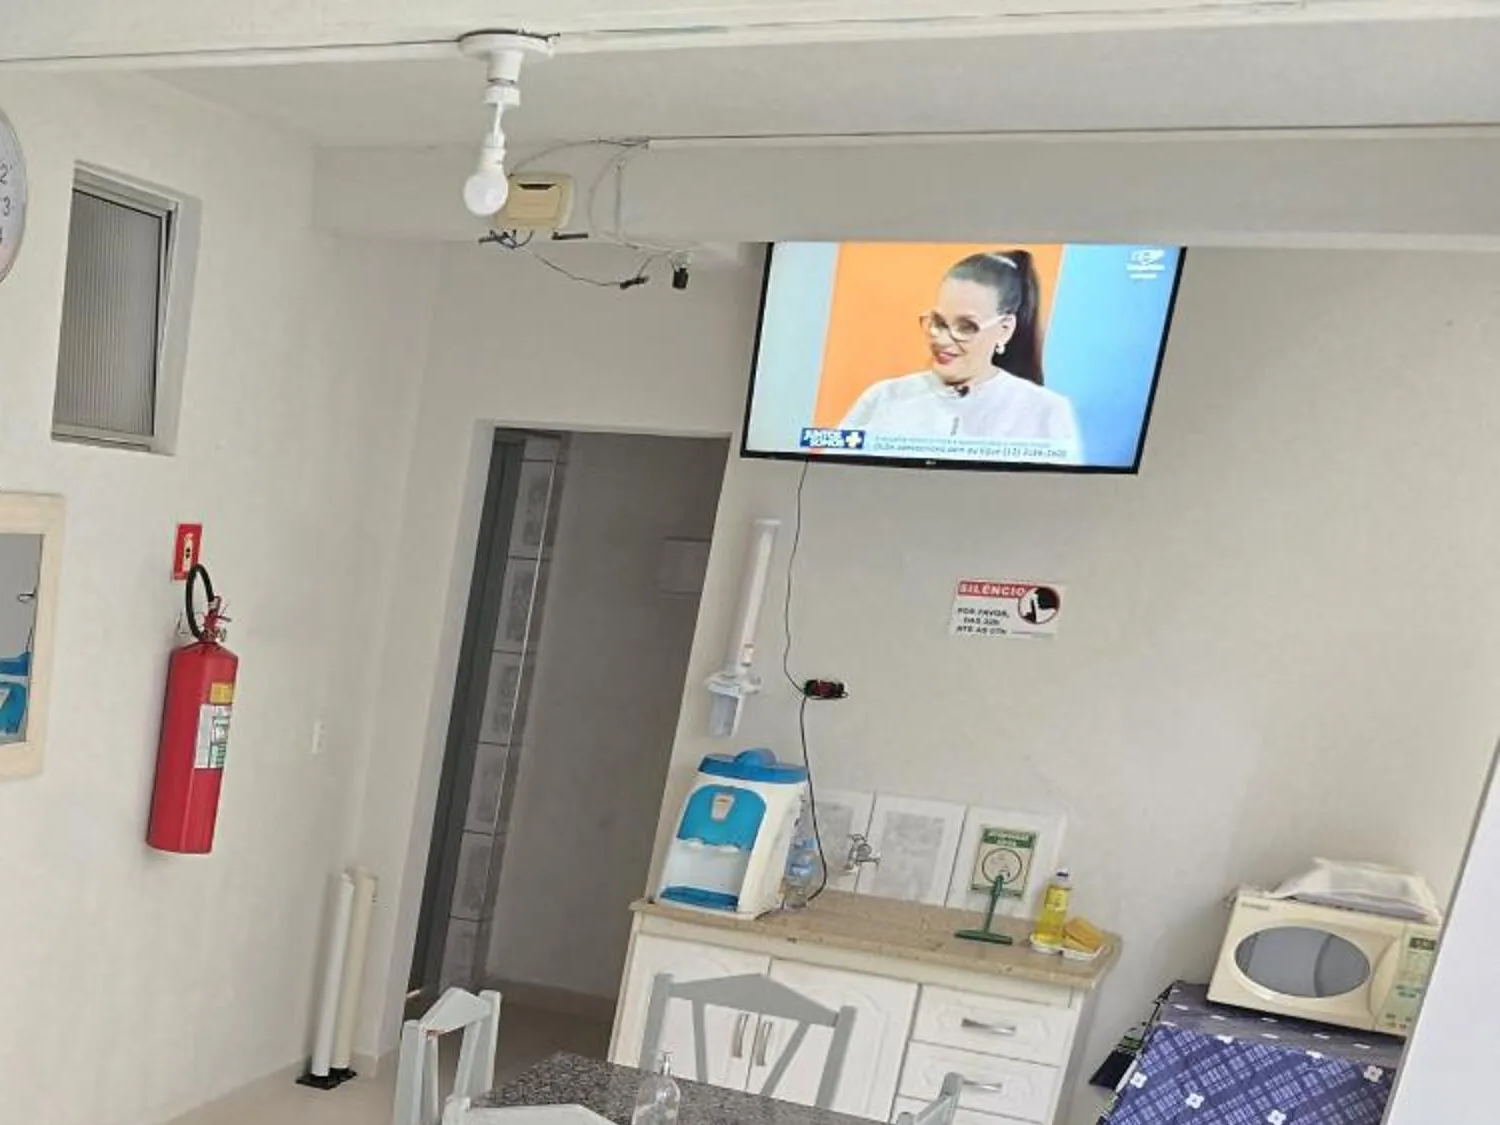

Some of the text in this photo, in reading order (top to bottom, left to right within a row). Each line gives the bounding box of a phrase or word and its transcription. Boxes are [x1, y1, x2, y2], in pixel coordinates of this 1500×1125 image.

[0, 163, 9, 185] 2
[3, 196, 11, 217] 3
[959, 582, 1026, 597] SILÊNCIO
[957, 607, 975, 615] POR
[963, 616, 981, 624] DAS
